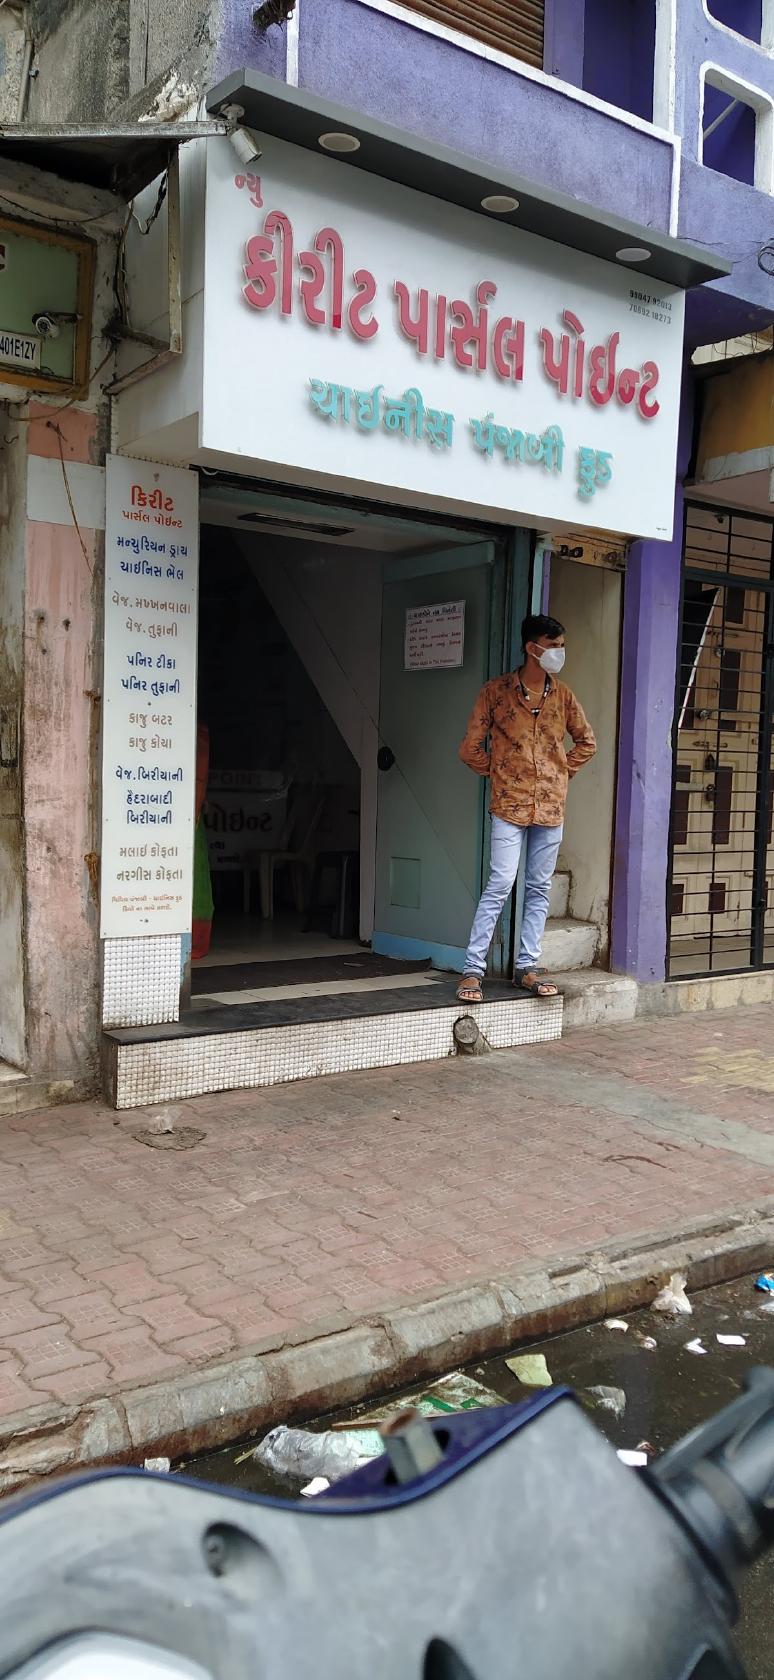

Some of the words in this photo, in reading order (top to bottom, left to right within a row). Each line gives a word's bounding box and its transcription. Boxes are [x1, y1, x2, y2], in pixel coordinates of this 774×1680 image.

[242, 210, 379, 339] કીરીટ
[394, 279, 525, 382] પાર્સલ
[131, 485, 174, 511] કિરીટ
[122, 510, 150, 523] પાર્સલ
[166, 564, 184, 580] ભેલ
[127, 651, 153, 667] પનિર
[156, 654, 176, 669] ટીકા
[121, 675, 148, 690] પનિર
[150, 679, 180, 697] તુફાની
[129, 713, 148, 728] કાજુ
[151, 714, 172, 726] બટર
[129, 737, 148, 752] કાજુ
[126, 809, 172, 824] બિરીયાની
[150, 842, 178, 858] કોફતા
[116, 866, 152, 881] નરગીસ
[155, 865, 183, 881] કોફતા
